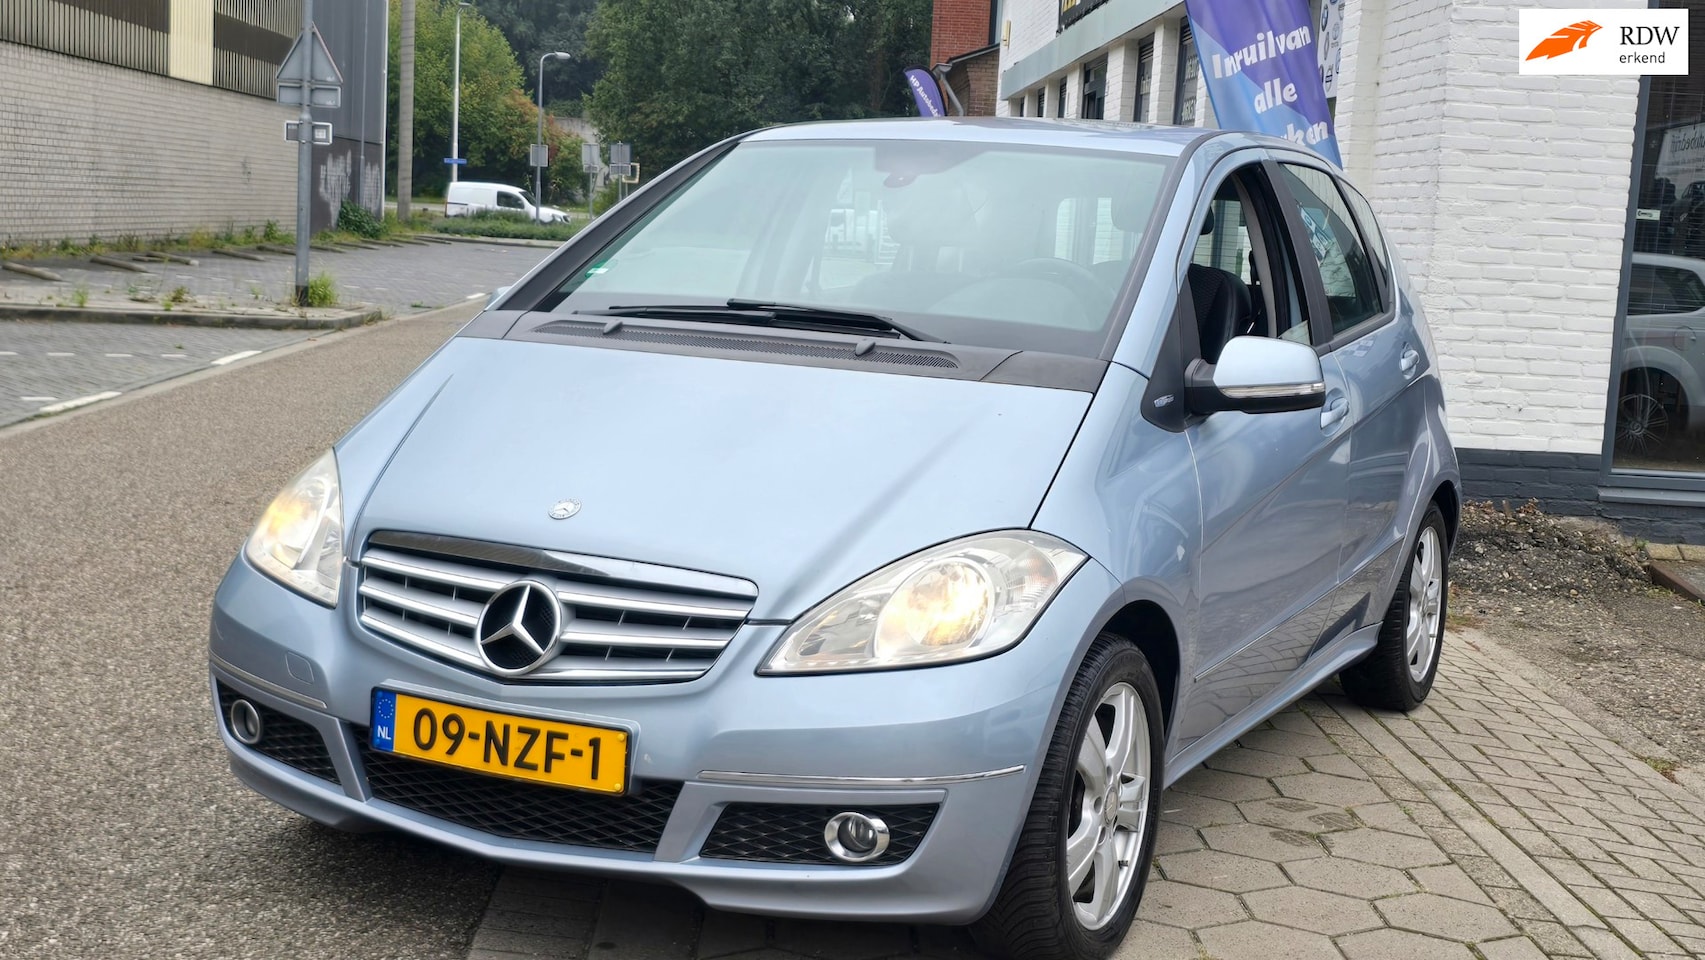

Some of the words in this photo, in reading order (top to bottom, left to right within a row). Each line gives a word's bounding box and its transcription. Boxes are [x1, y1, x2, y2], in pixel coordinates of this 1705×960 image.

[916, 86, 941, 117] Autobedr
[1254, 78, 1298, 114] alle
[1280, 121, 1329, 146] ken
[377, 724, 392, 741] NL
[413, 707, 601, 780] 09-NZF-1
